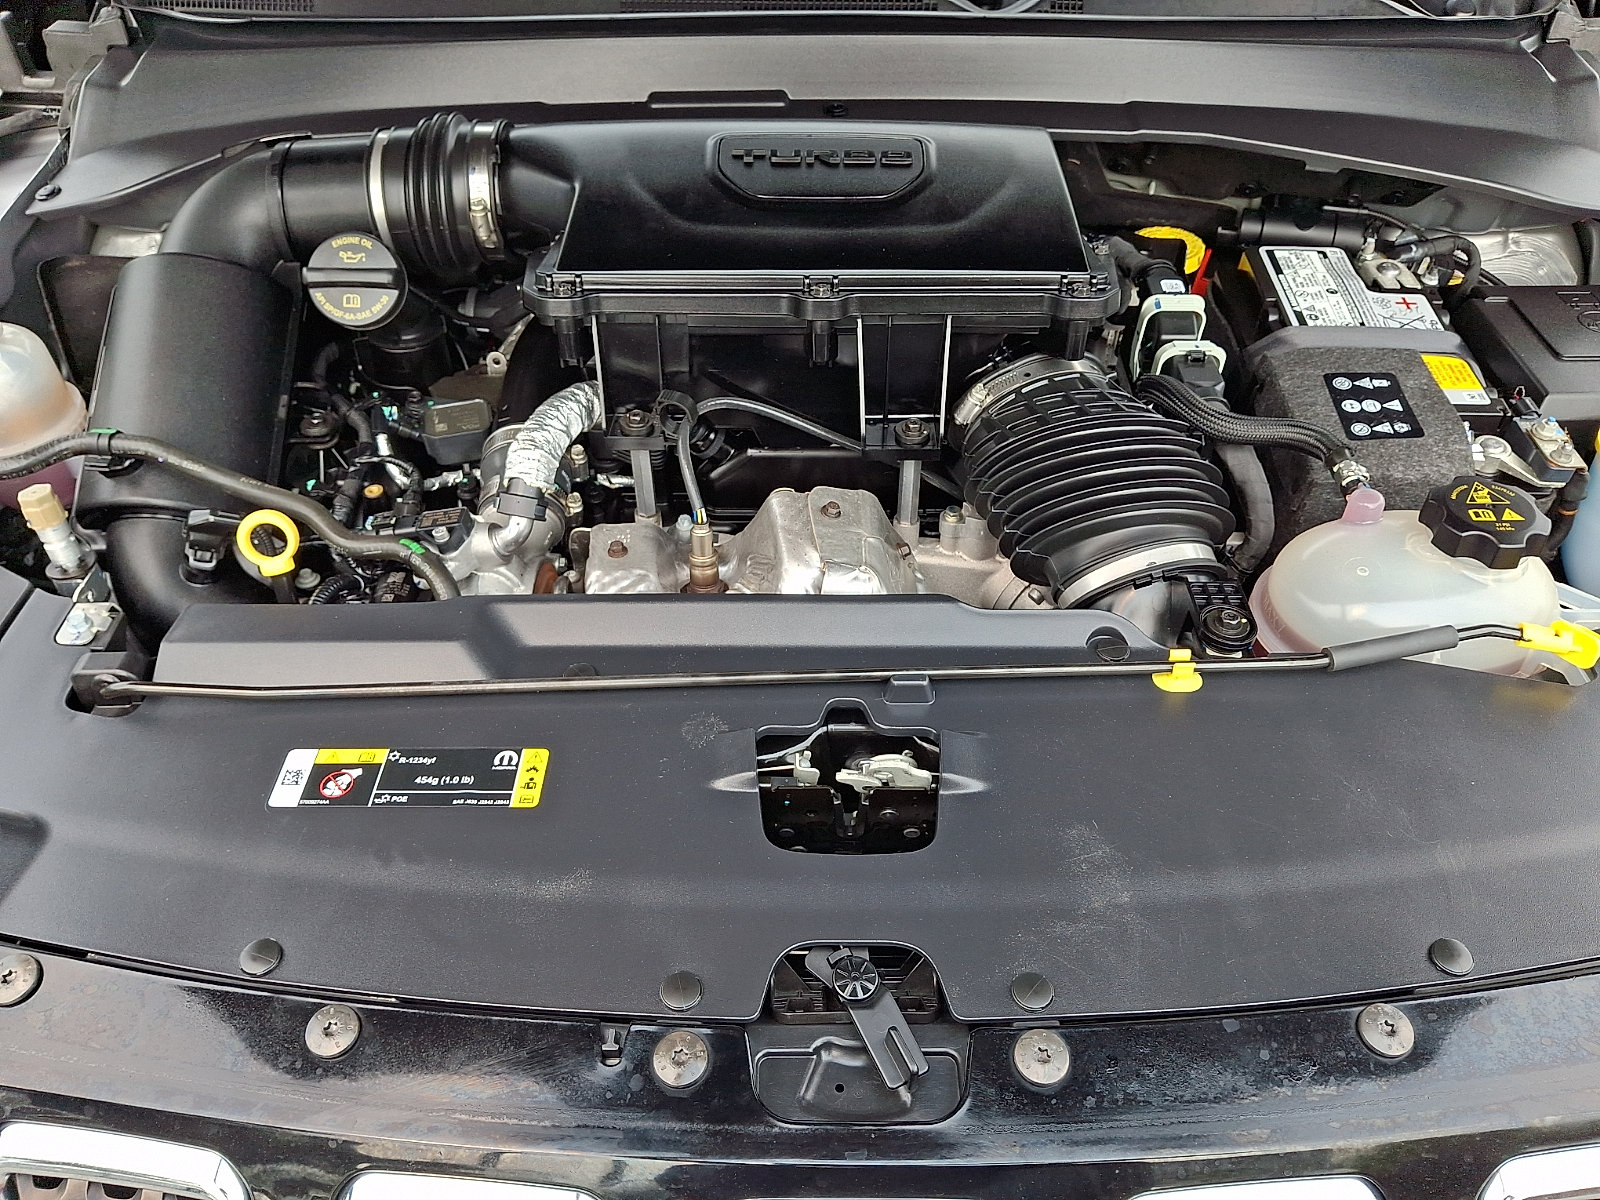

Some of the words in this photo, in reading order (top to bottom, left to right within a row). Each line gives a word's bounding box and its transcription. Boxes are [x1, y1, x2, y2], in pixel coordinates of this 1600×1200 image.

[731, 149, 913, 169] TURBO
[332, 237, 361, 248] ENGINE
[361, 239, 373, 249] OIL
[315, 293, 326, 305] API
[398, 756, 437, 766] R-1234yf
[414, 775, 439, 786] 454g
[440, 775, 459, 786] (1.0
[460, 775, 474, 785] lb)
[390, 795, 409, 803] POE
